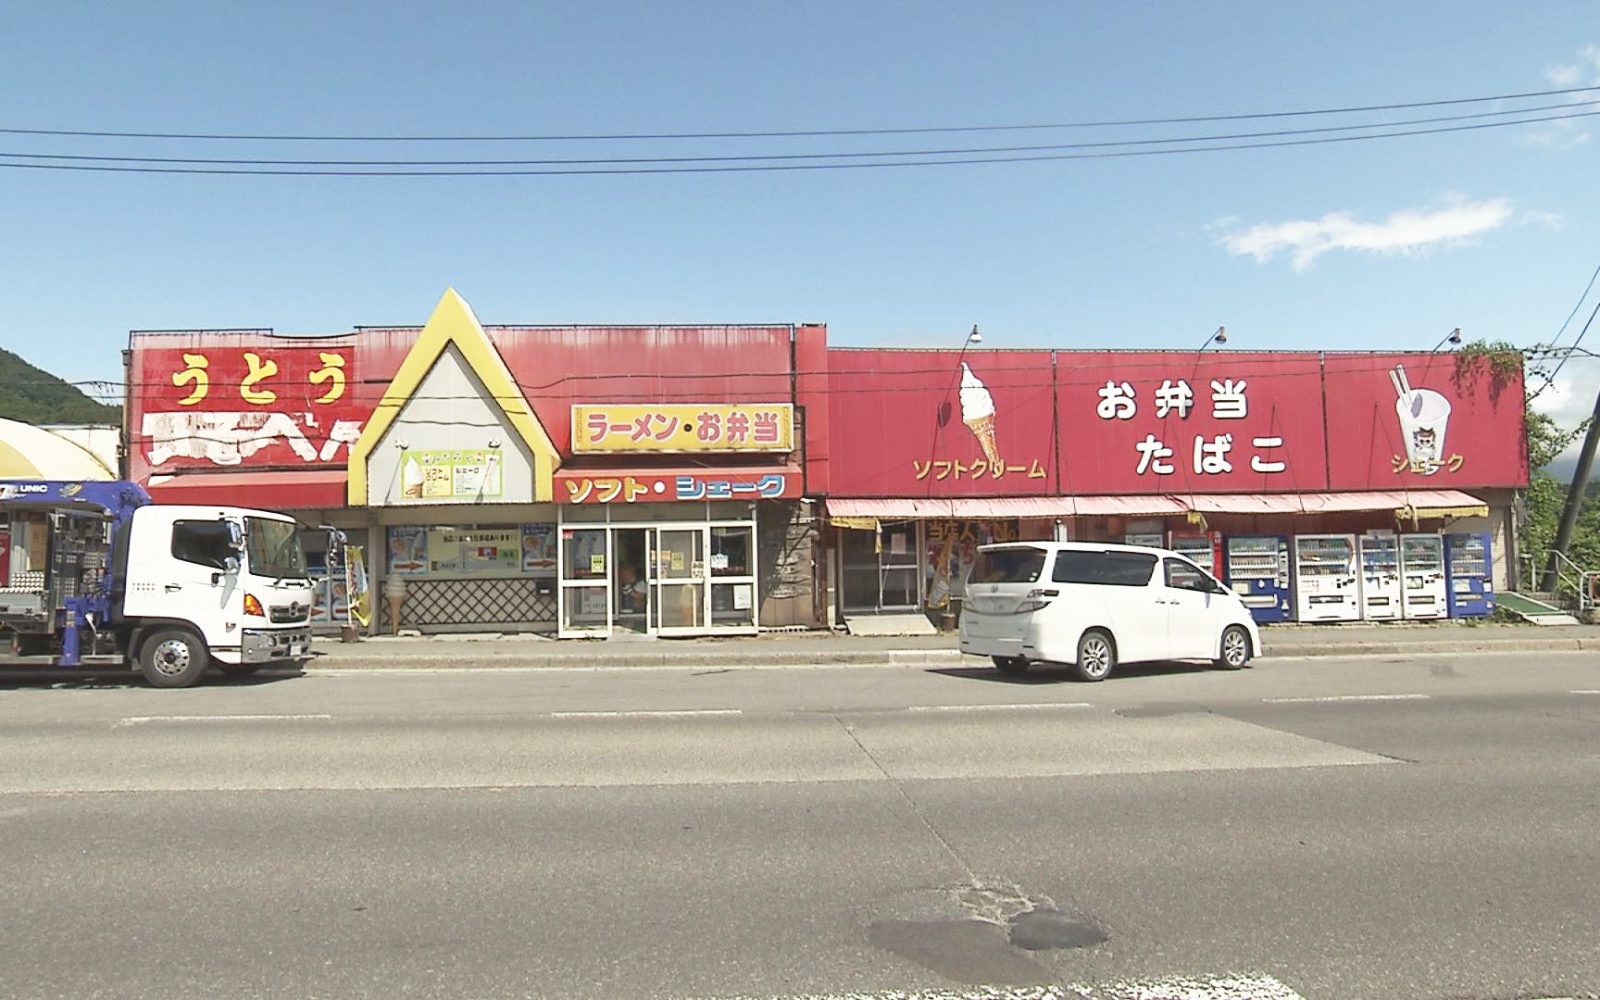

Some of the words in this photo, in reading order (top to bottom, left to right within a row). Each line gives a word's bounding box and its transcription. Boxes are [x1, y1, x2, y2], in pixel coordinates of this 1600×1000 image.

[172, 352, 346, 406] うとう
[1097, 379, 1248, 419] お弁当
[587, 411, 779, 443] ラーメン・お弁当
[1136, 433, 1286, 475] たばこ
[1391, 453, 1464, 473] シェーク
[913, 459, 1047, 480] ソフトクリーム
[20, 485, 48, 493] UNIC
[565, 474, 786, 503] ソフト・シェーク
